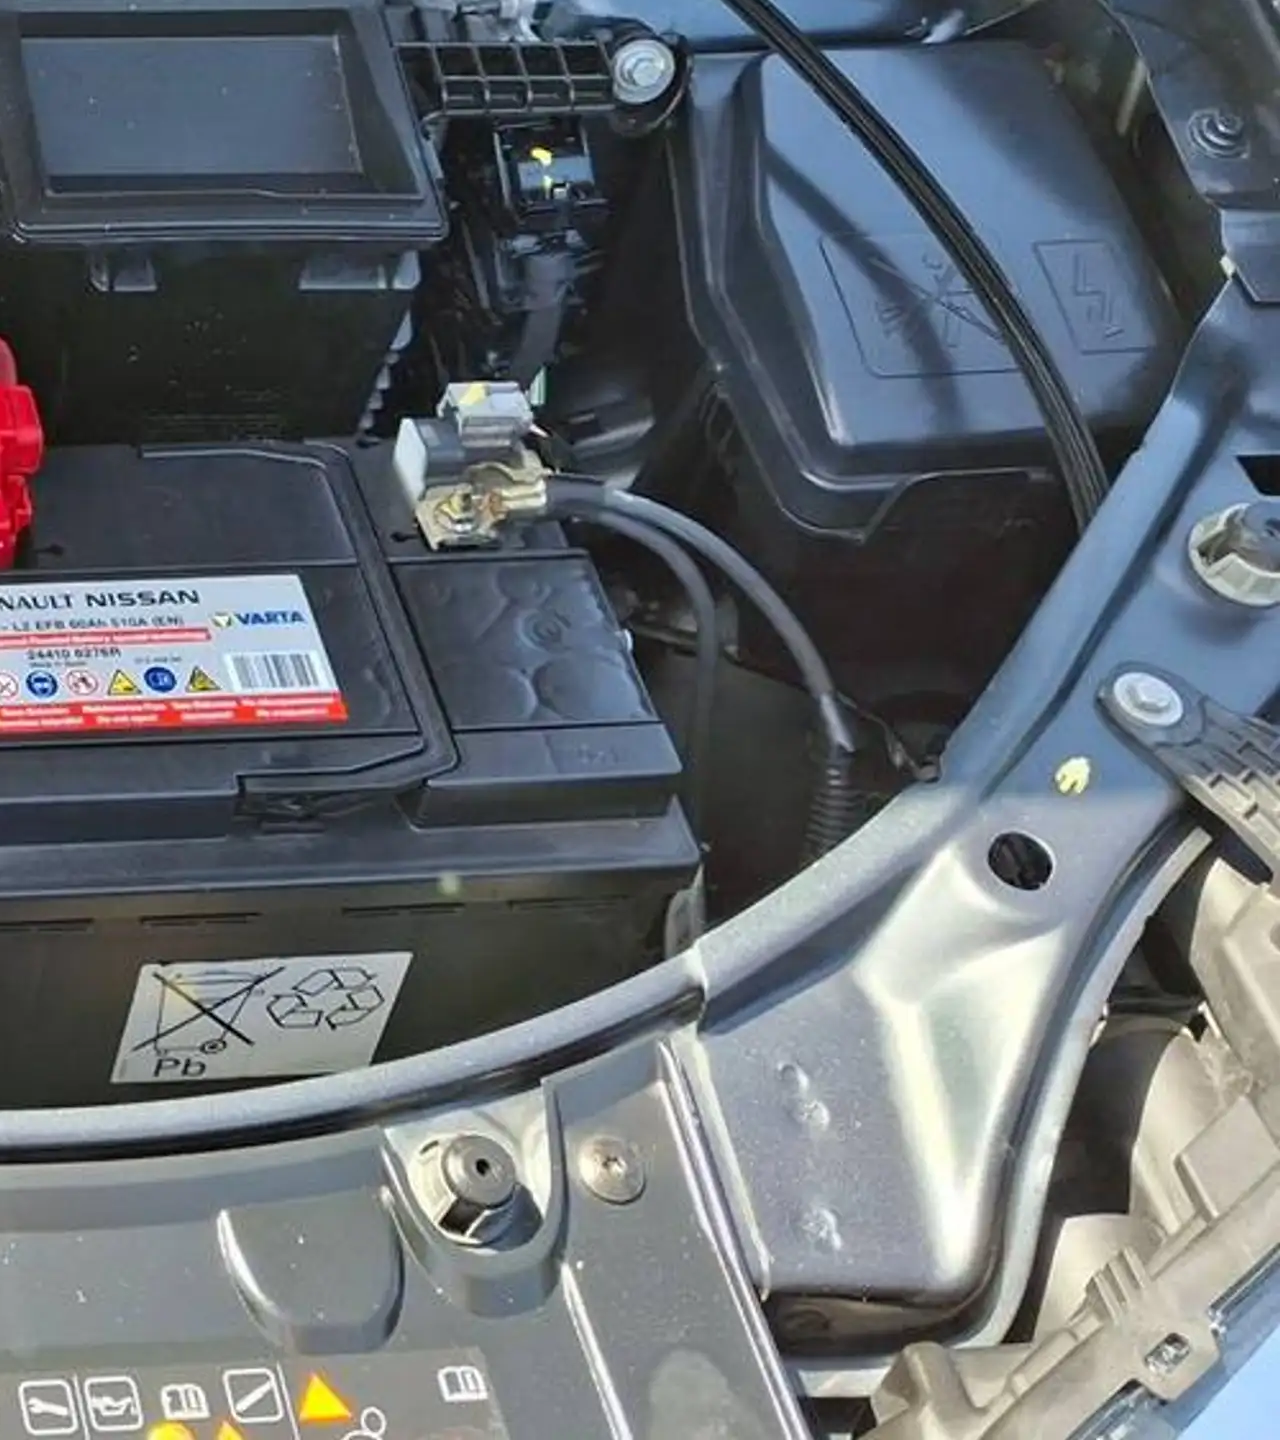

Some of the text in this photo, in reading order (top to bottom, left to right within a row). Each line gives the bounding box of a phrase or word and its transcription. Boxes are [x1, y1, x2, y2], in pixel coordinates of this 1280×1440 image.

[86, 590, 201, 608] NISSAN
[237, 611, 306, 626] VARTA
[153, 1058, 206, 1078] Pb
